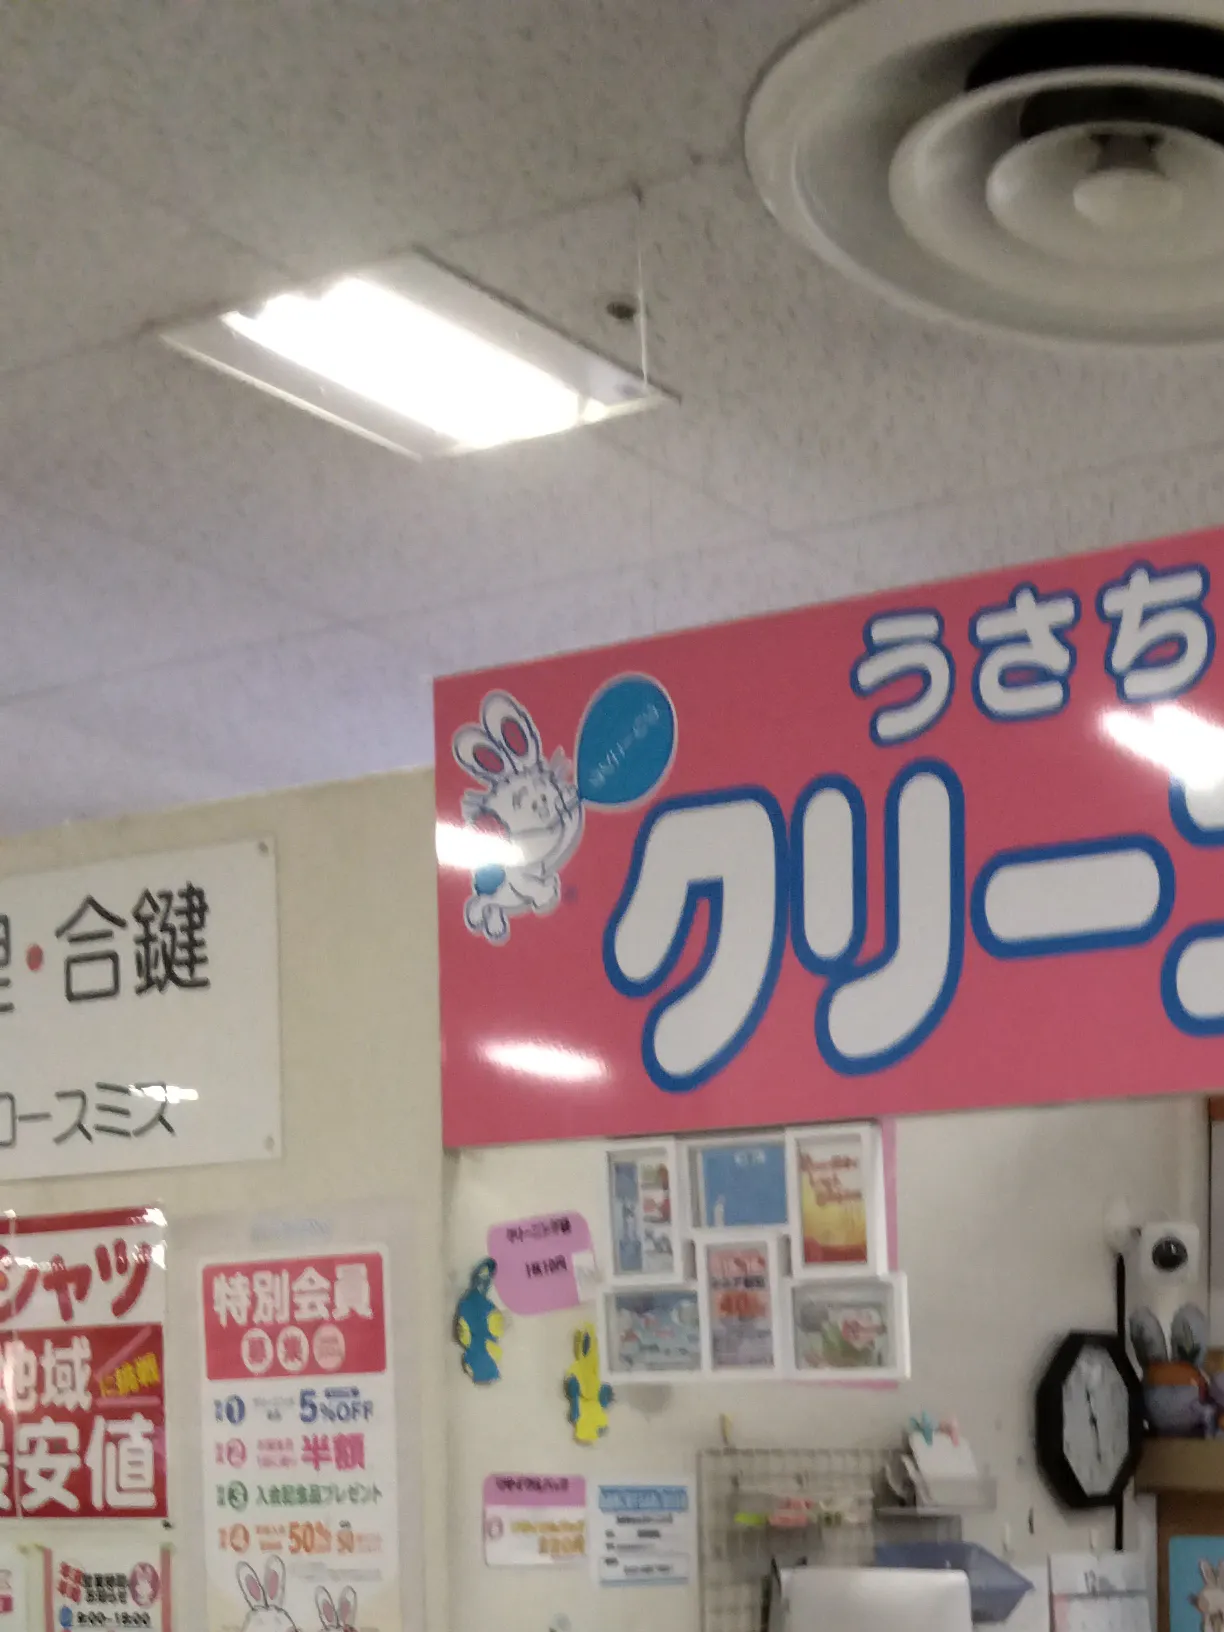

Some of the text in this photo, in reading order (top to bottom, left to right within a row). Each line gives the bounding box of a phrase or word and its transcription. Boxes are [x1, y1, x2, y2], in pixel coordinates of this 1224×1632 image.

[0, 881, 211, 1012] ・合鍵
[0, 1412, 158, 1513] 安値
